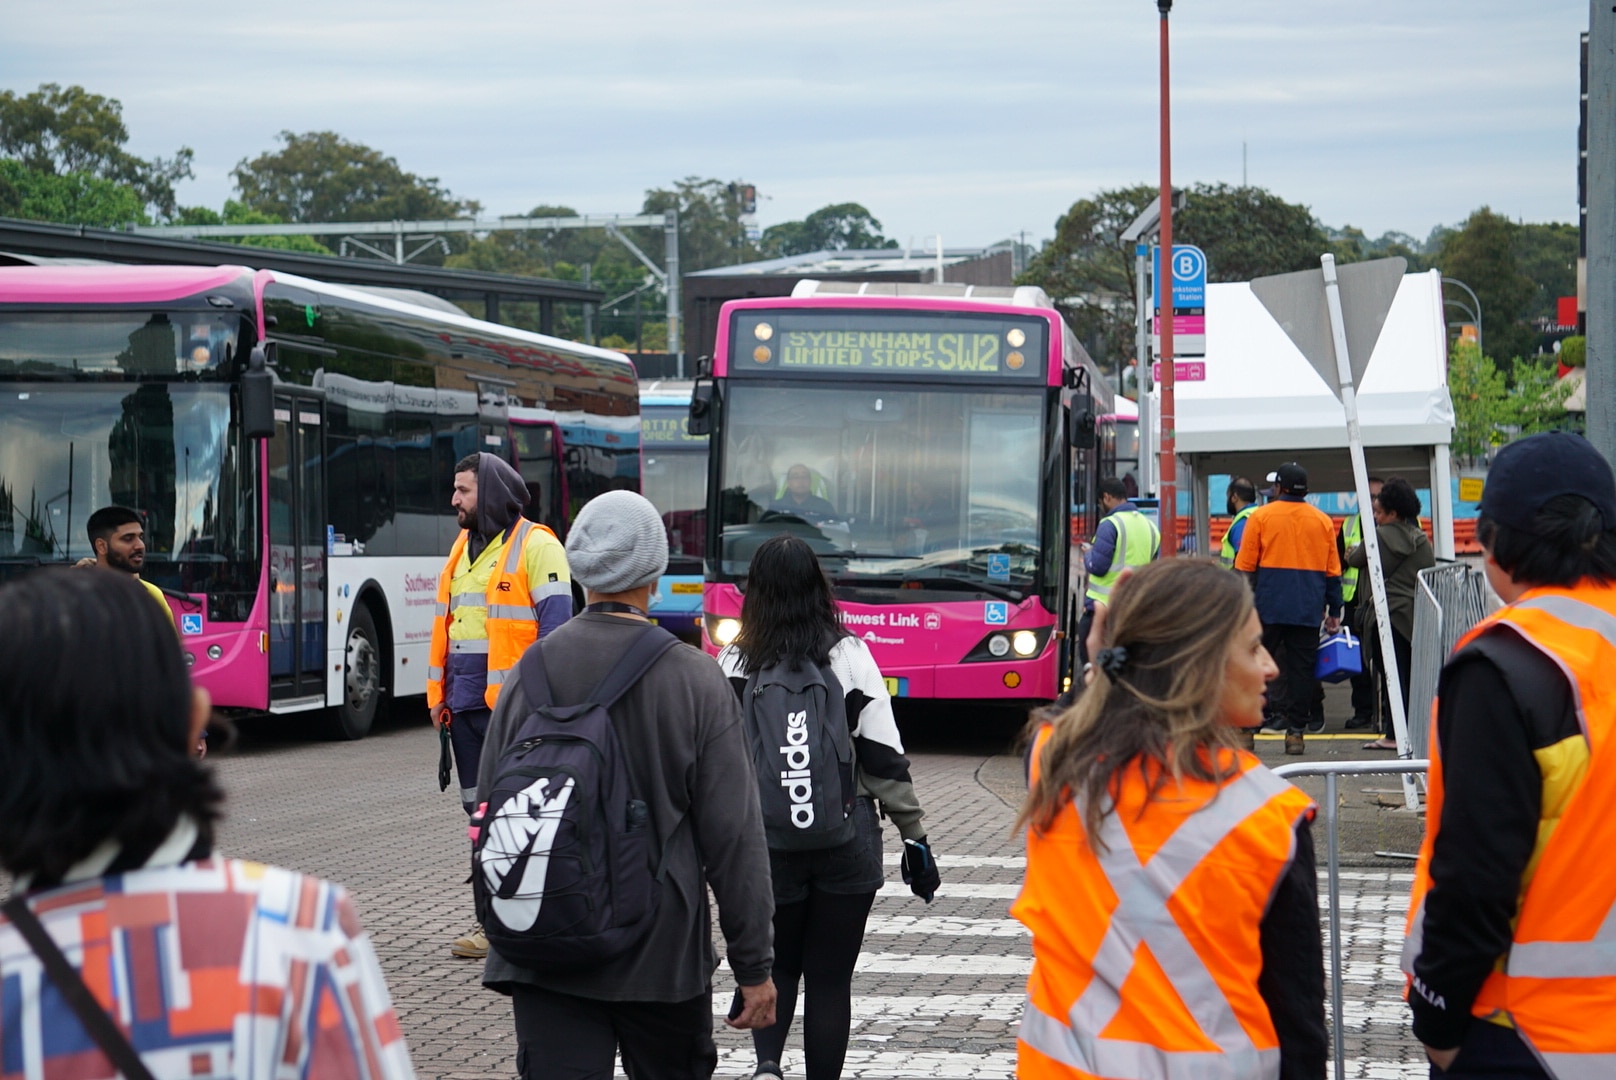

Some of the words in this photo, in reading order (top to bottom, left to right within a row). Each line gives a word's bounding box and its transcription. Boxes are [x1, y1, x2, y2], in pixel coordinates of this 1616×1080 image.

[1180, 256, 1193, 274] B
[1172, 285, 1203, 293] ankstown
[1178, 293, 1203, 301] Station
[789, 331, 931, 349] SYDENHAM
[783, 347, 862, 366] LIMITED
[871, 349, 934, 368] STOPS
[937, 333, 1000, 371] SW2
[642, 419, 678, 431] ATTA
[642, 431, 675, 441] OMBE
[838, 610, 886, 626] hwest
[889, 612, 920, 628] Link
[780, 709, 815, 829] adidas
[1413, 976, 1447, 1010] ALIA
